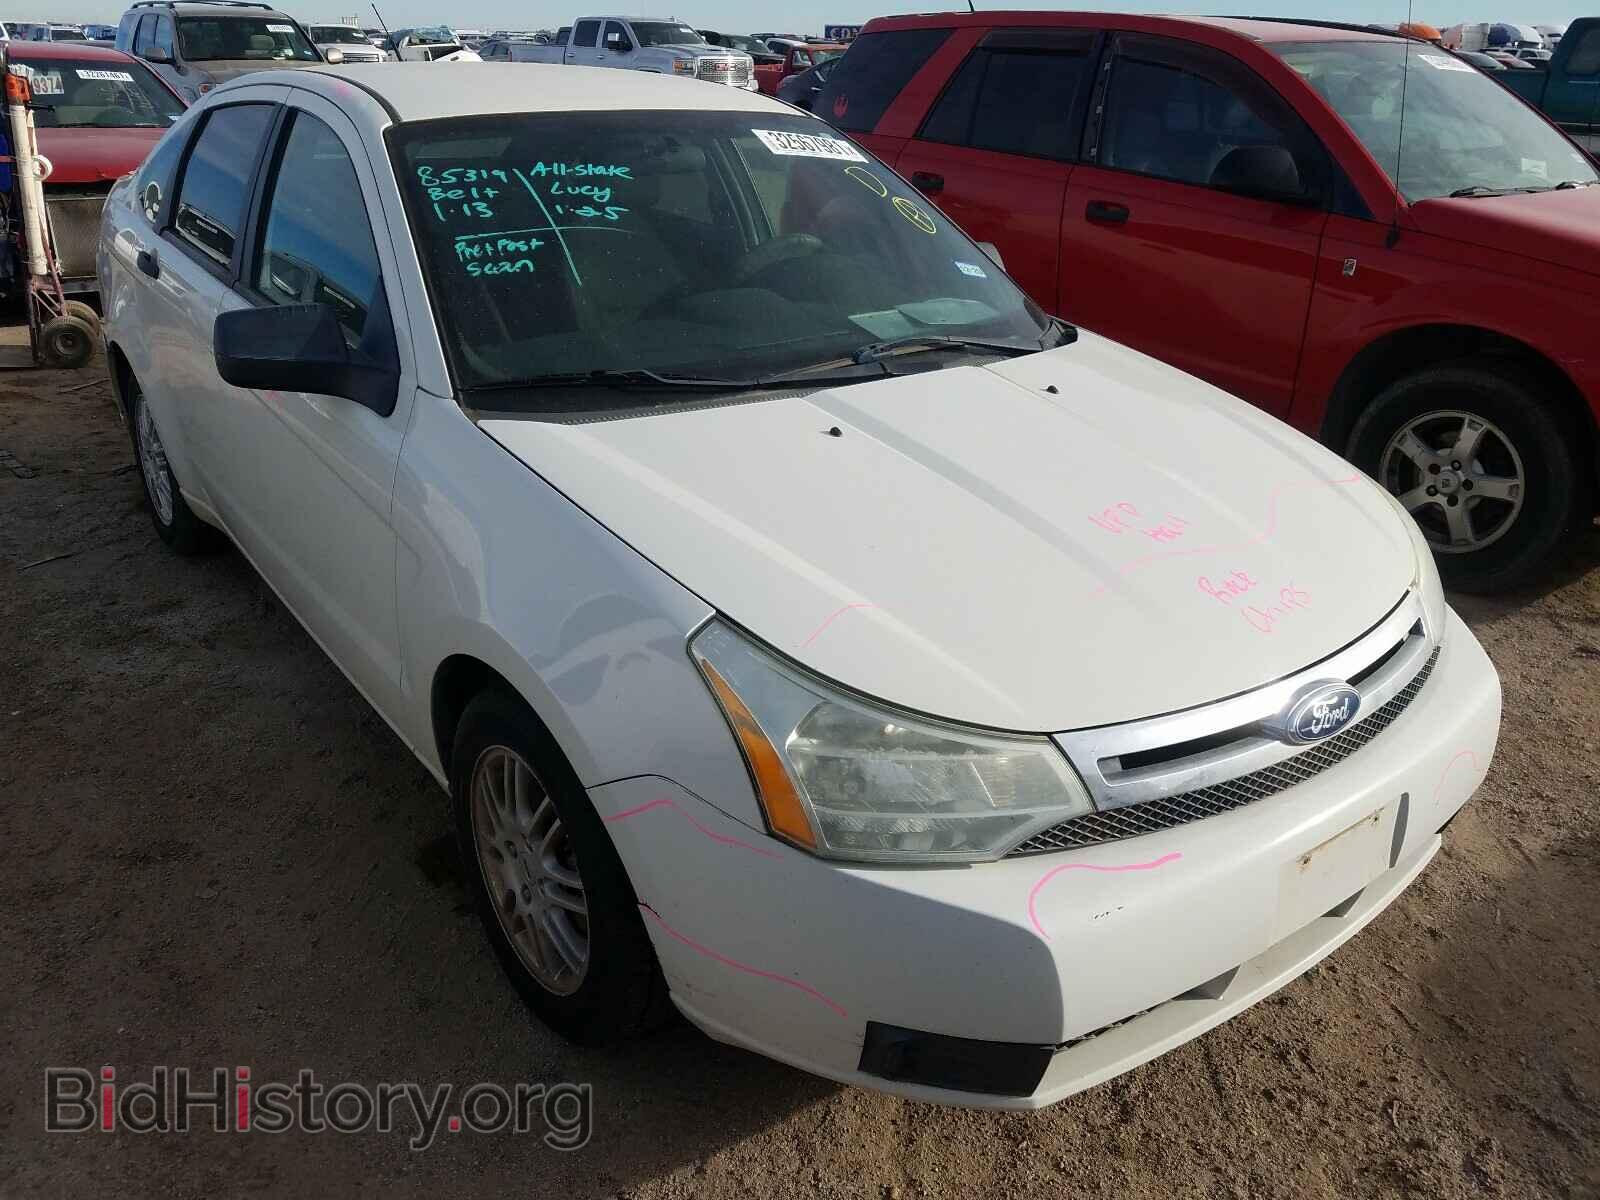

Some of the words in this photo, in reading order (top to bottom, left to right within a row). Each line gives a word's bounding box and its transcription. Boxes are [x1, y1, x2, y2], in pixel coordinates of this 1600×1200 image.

[767, 131, 850, 155] 32567981
[417, 166, 508, 187] 85319
[1304, 696, 1349, 734] Ford
